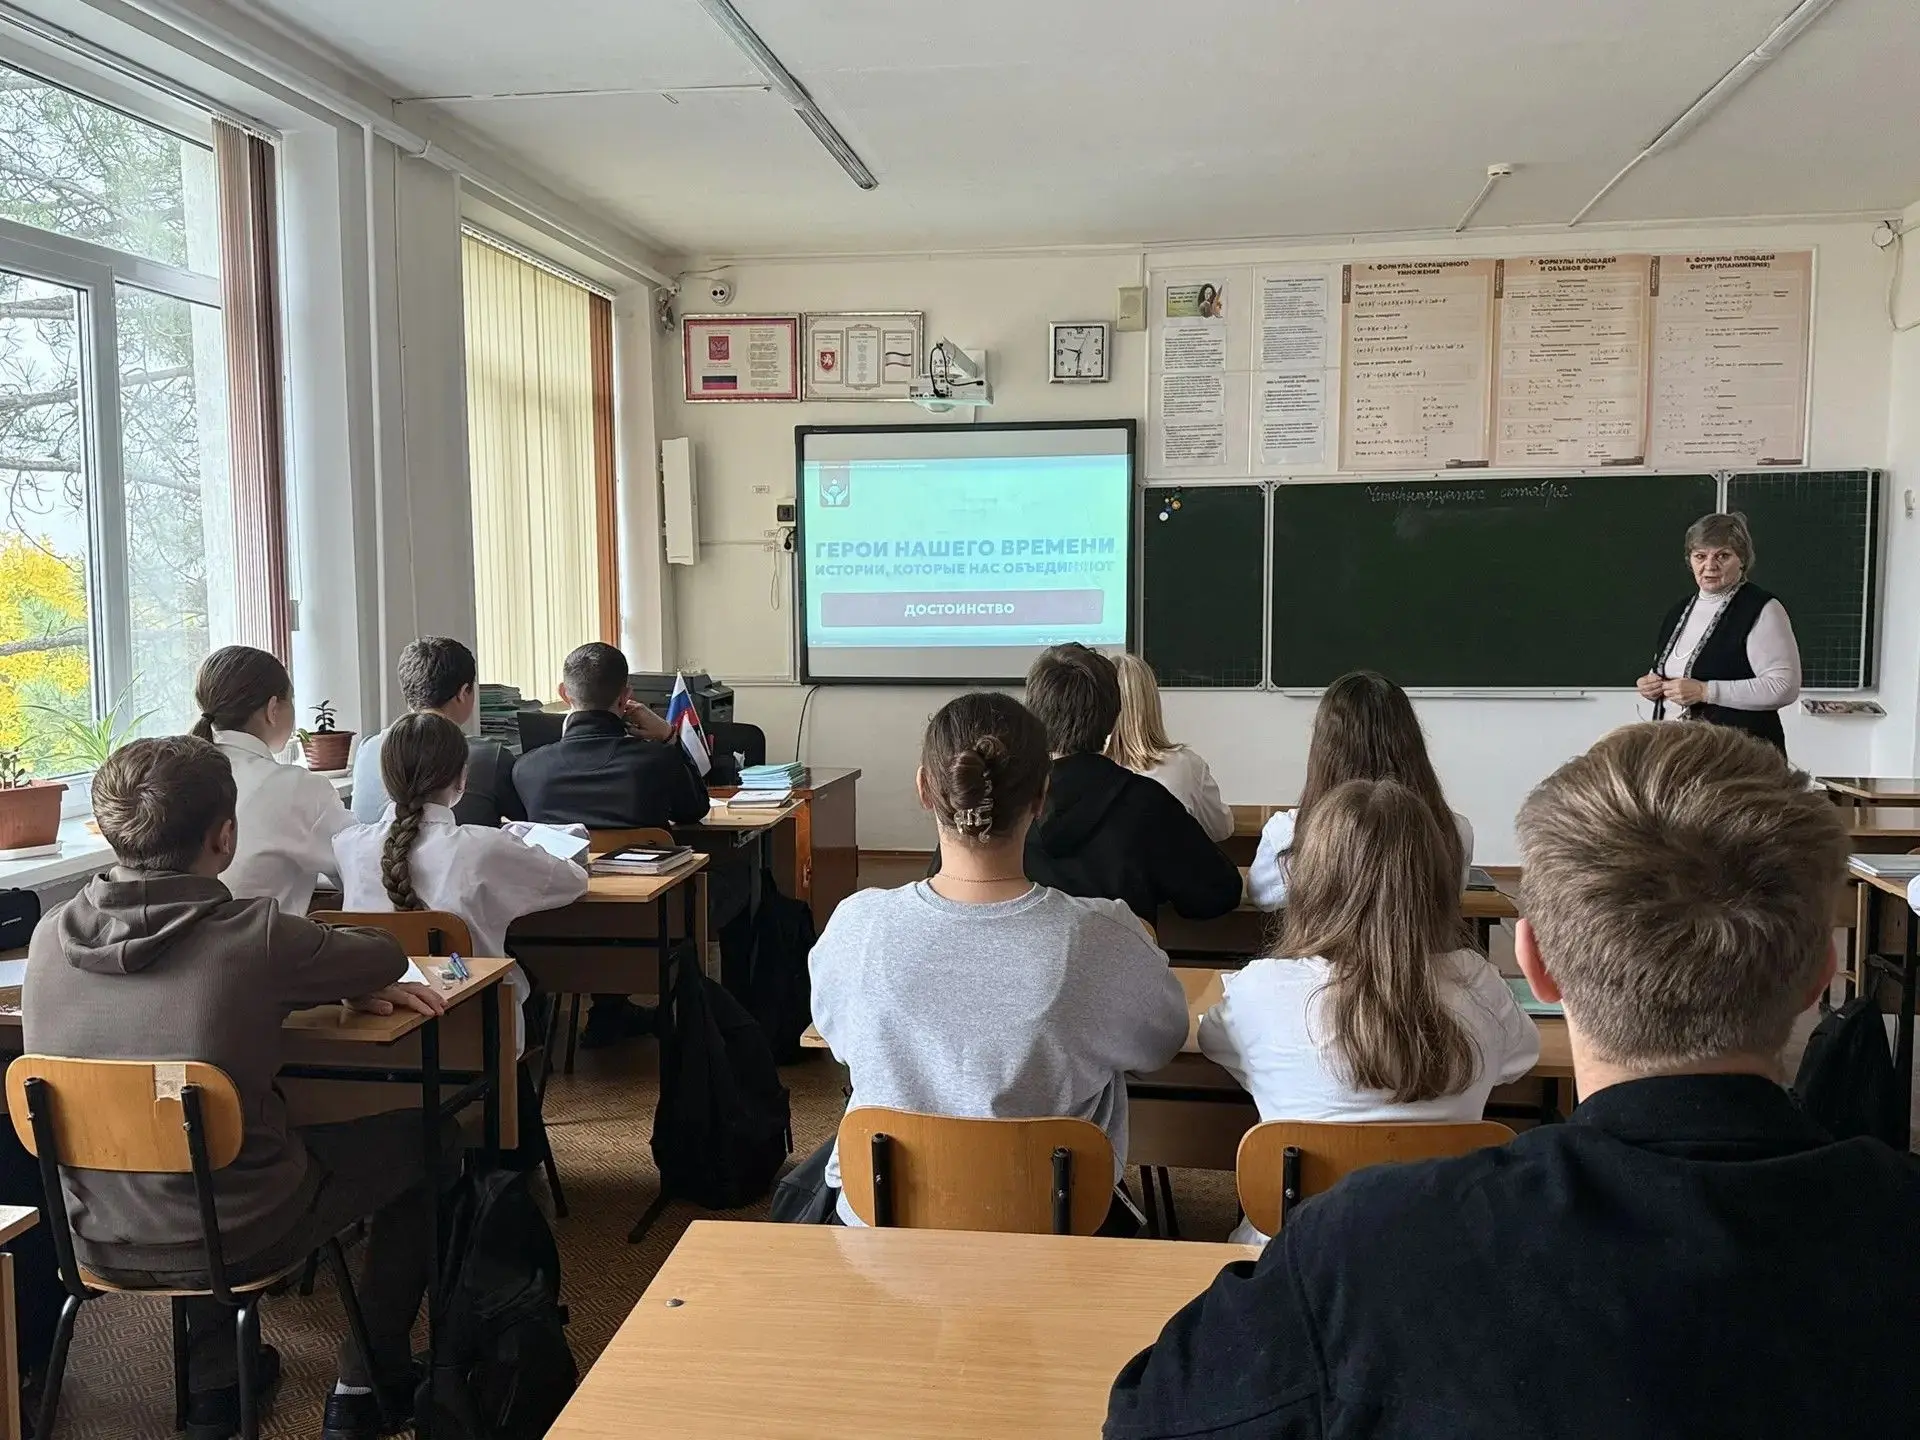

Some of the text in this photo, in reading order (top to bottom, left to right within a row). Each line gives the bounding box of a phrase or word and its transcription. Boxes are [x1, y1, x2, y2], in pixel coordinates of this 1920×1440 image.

[1538, 258, 1574, 266] ФОРМУЛЫ
[1575, 256, 1617, 264] ПЛОЩАДЕЙ
[1733, 254, 1775, 262] ПЛОЩАДЕЙ
[1377, 263, 1413, 271] ФОРМУЛЫ
[1414, 260, 1469, 269] СОКРАЩЕННОГО
[1714, 262, 1770, 271] (ПЛАНИМЕТРИЯ)
[815, 537, 1115, 558] ГЕРОИ НАШЕГО ВРЕМЕНИ
[815, 564, 890, 577] ИСТОРИИ,
[893, 563, 966, 575] КОТОРЫЕ
[969, 562, 1000, 574] НАС
[904, 603, 1015, 617] ДОСТОИНСТВО
